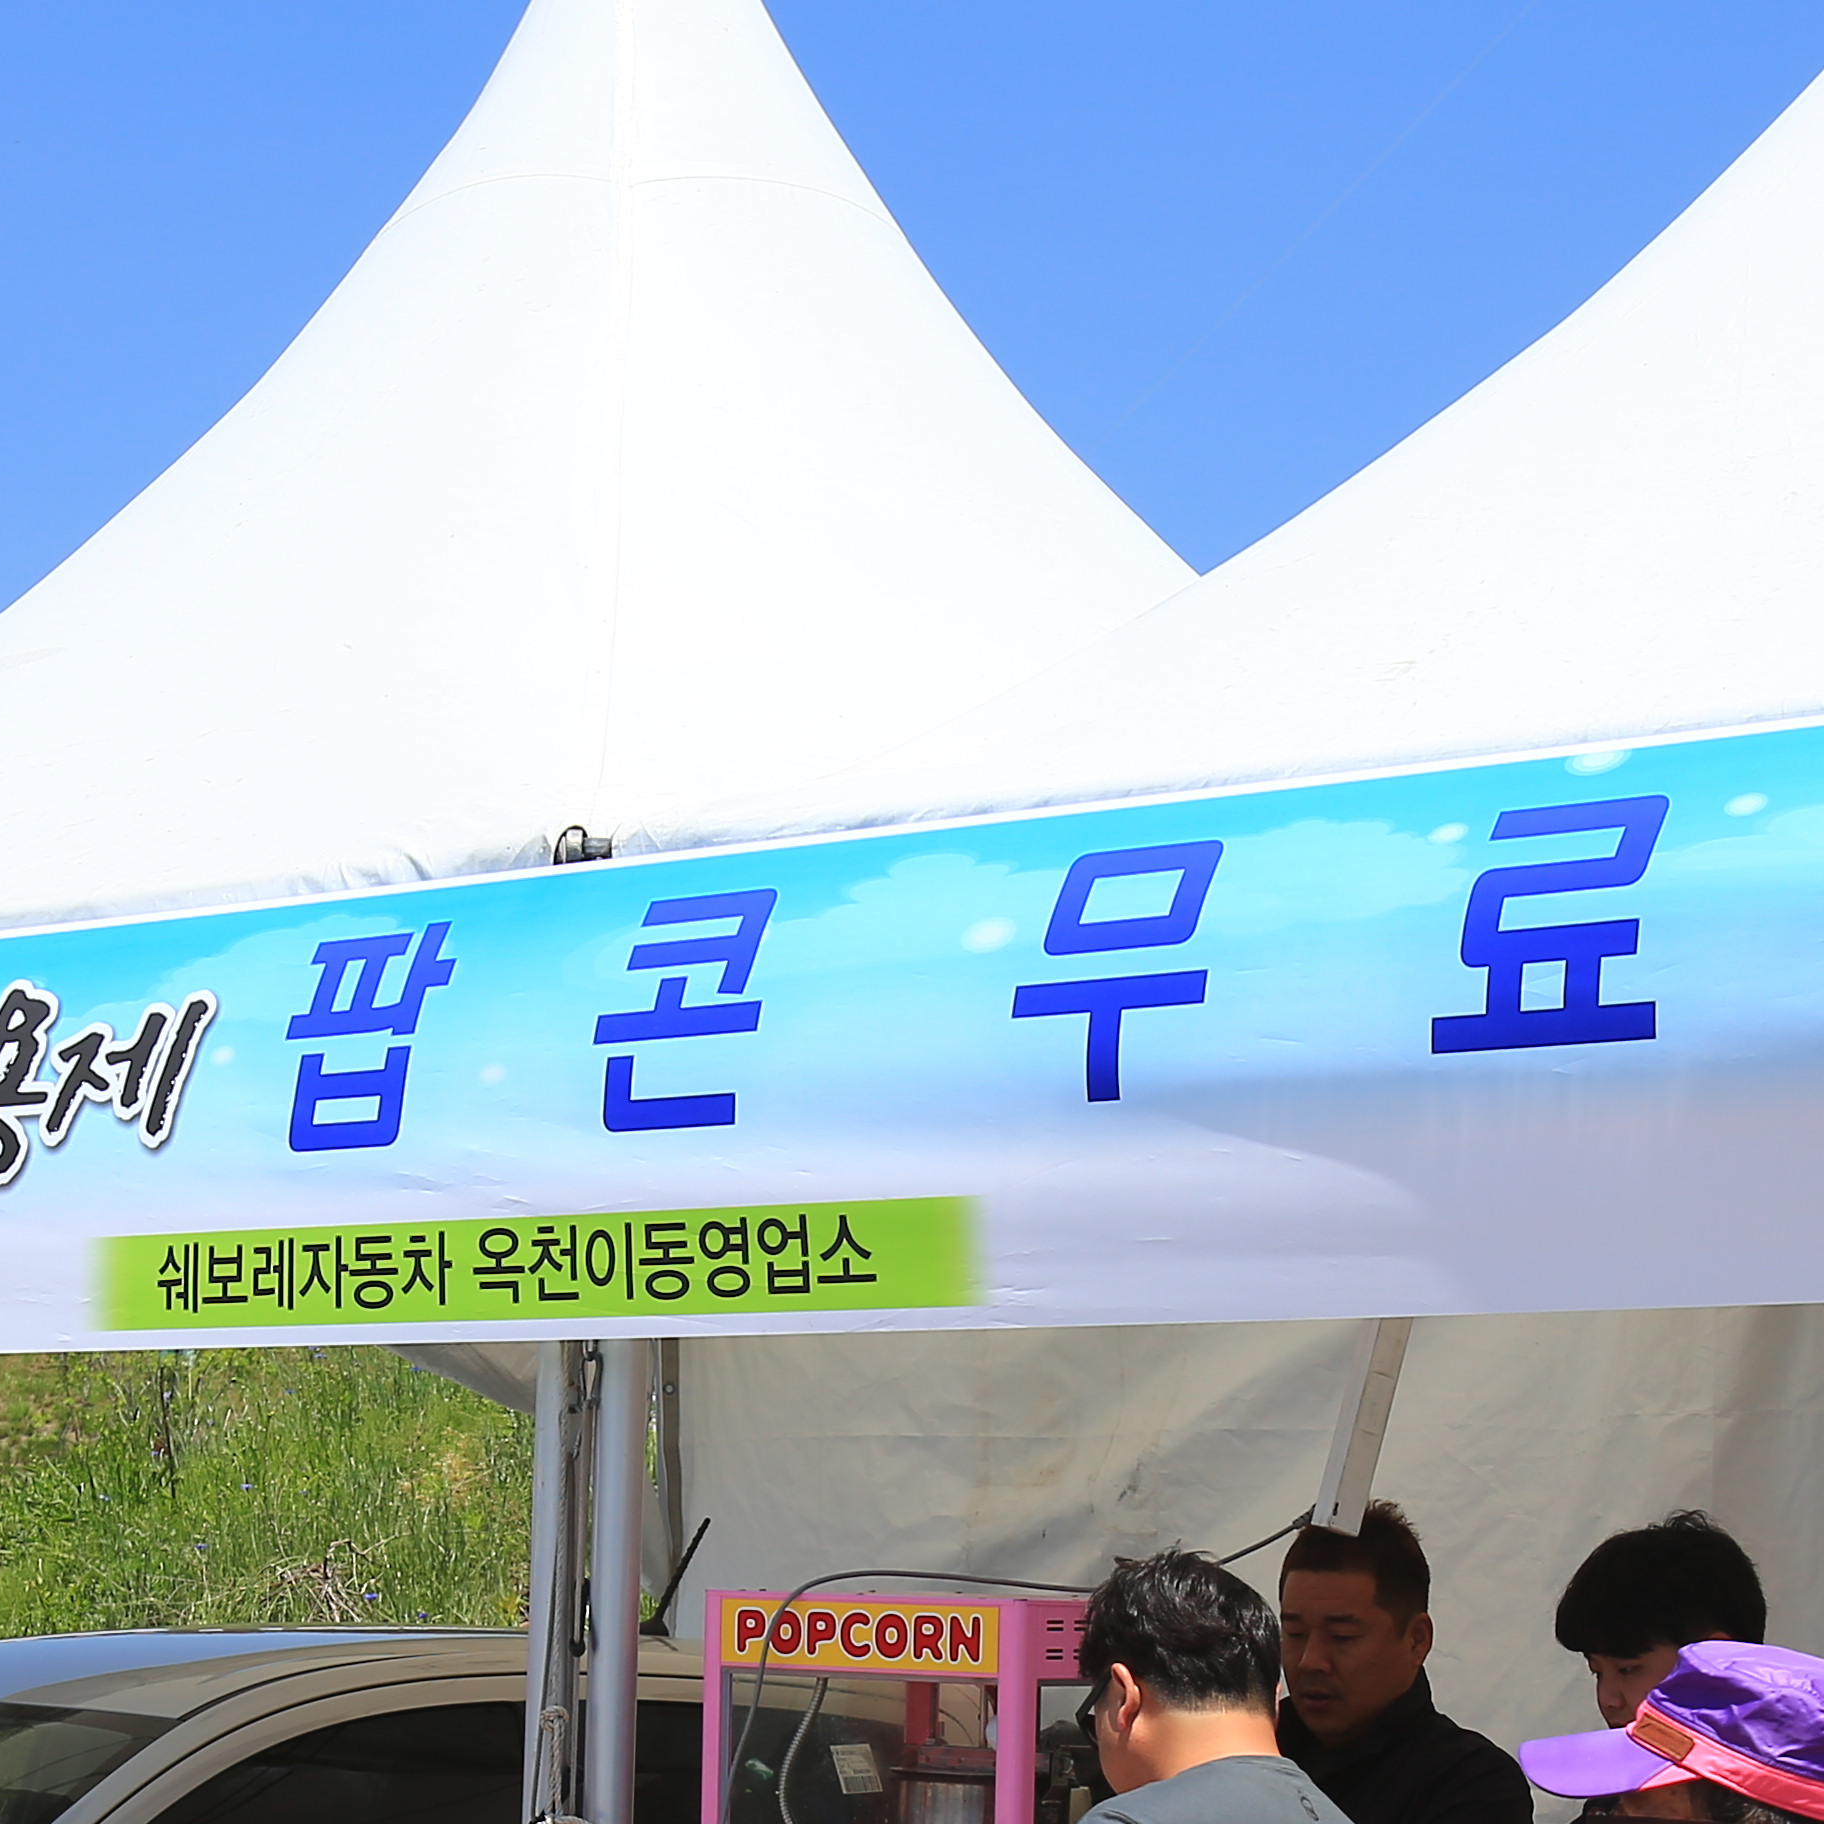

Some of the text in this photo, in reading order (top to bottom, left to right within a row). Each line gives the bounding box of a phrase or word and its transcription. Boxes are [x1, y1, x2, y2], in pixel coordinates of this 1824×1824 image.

[156, 1213, 879, 1313] 쉐보레자동차 옥천이동영업소
[735, 1607, 983, 1665] POPCORN
